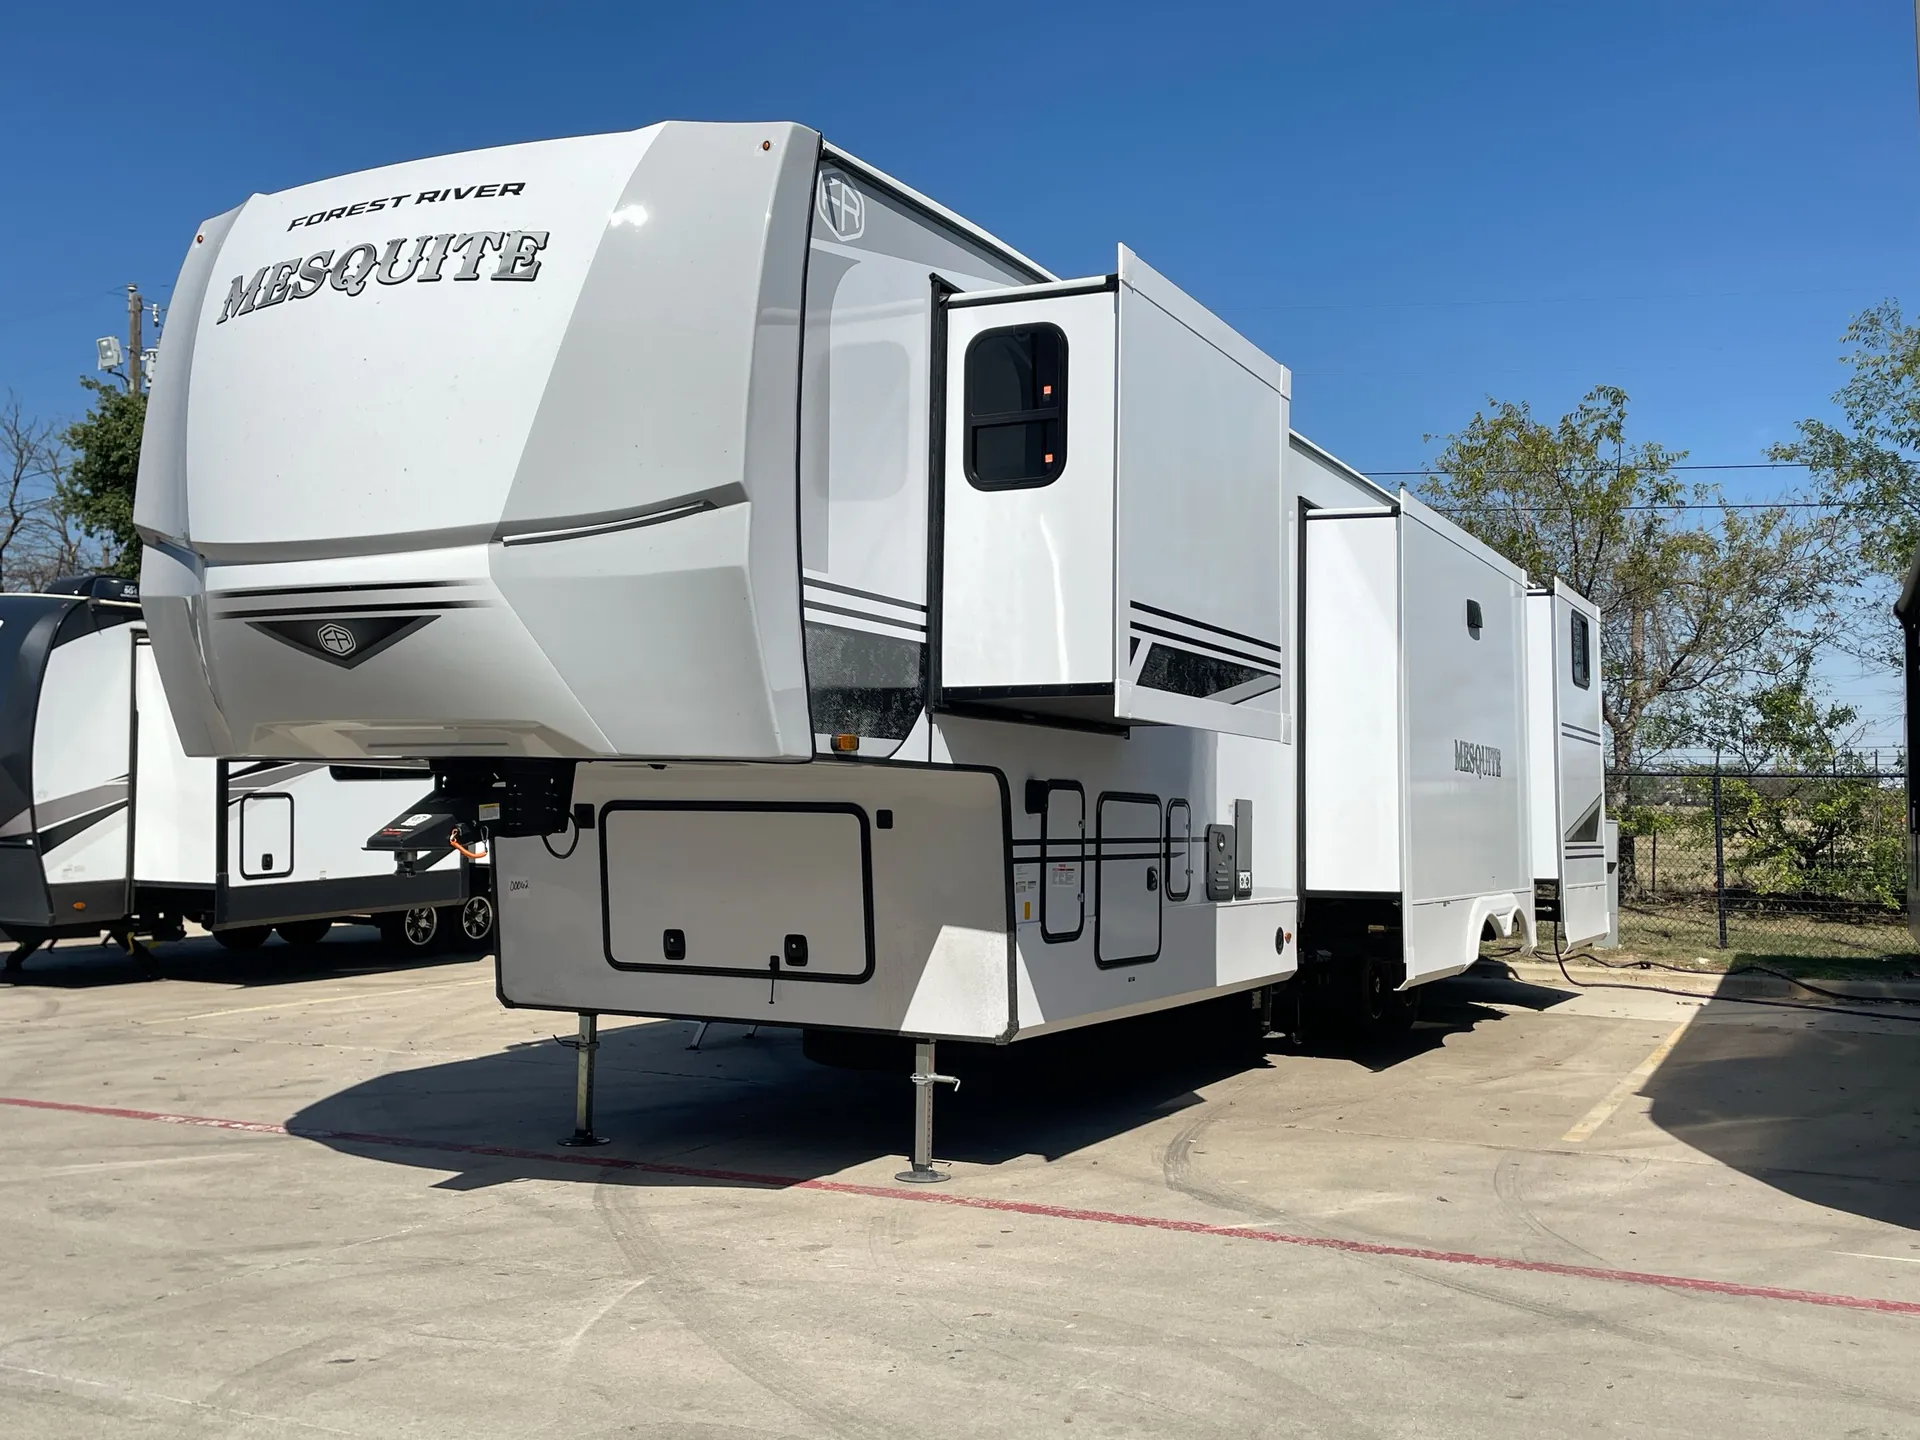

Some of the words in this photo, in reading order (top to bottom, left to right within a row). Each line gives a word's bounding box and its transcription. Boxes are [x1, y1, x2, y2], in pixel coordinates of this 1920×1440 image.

[287, 194, 411, 231] FOREST
[415, 182, 526, 205] RIVER
[216, 230, 550, 325] MESQUITE
[1454, 739, 1502, 779] MESQUITE
